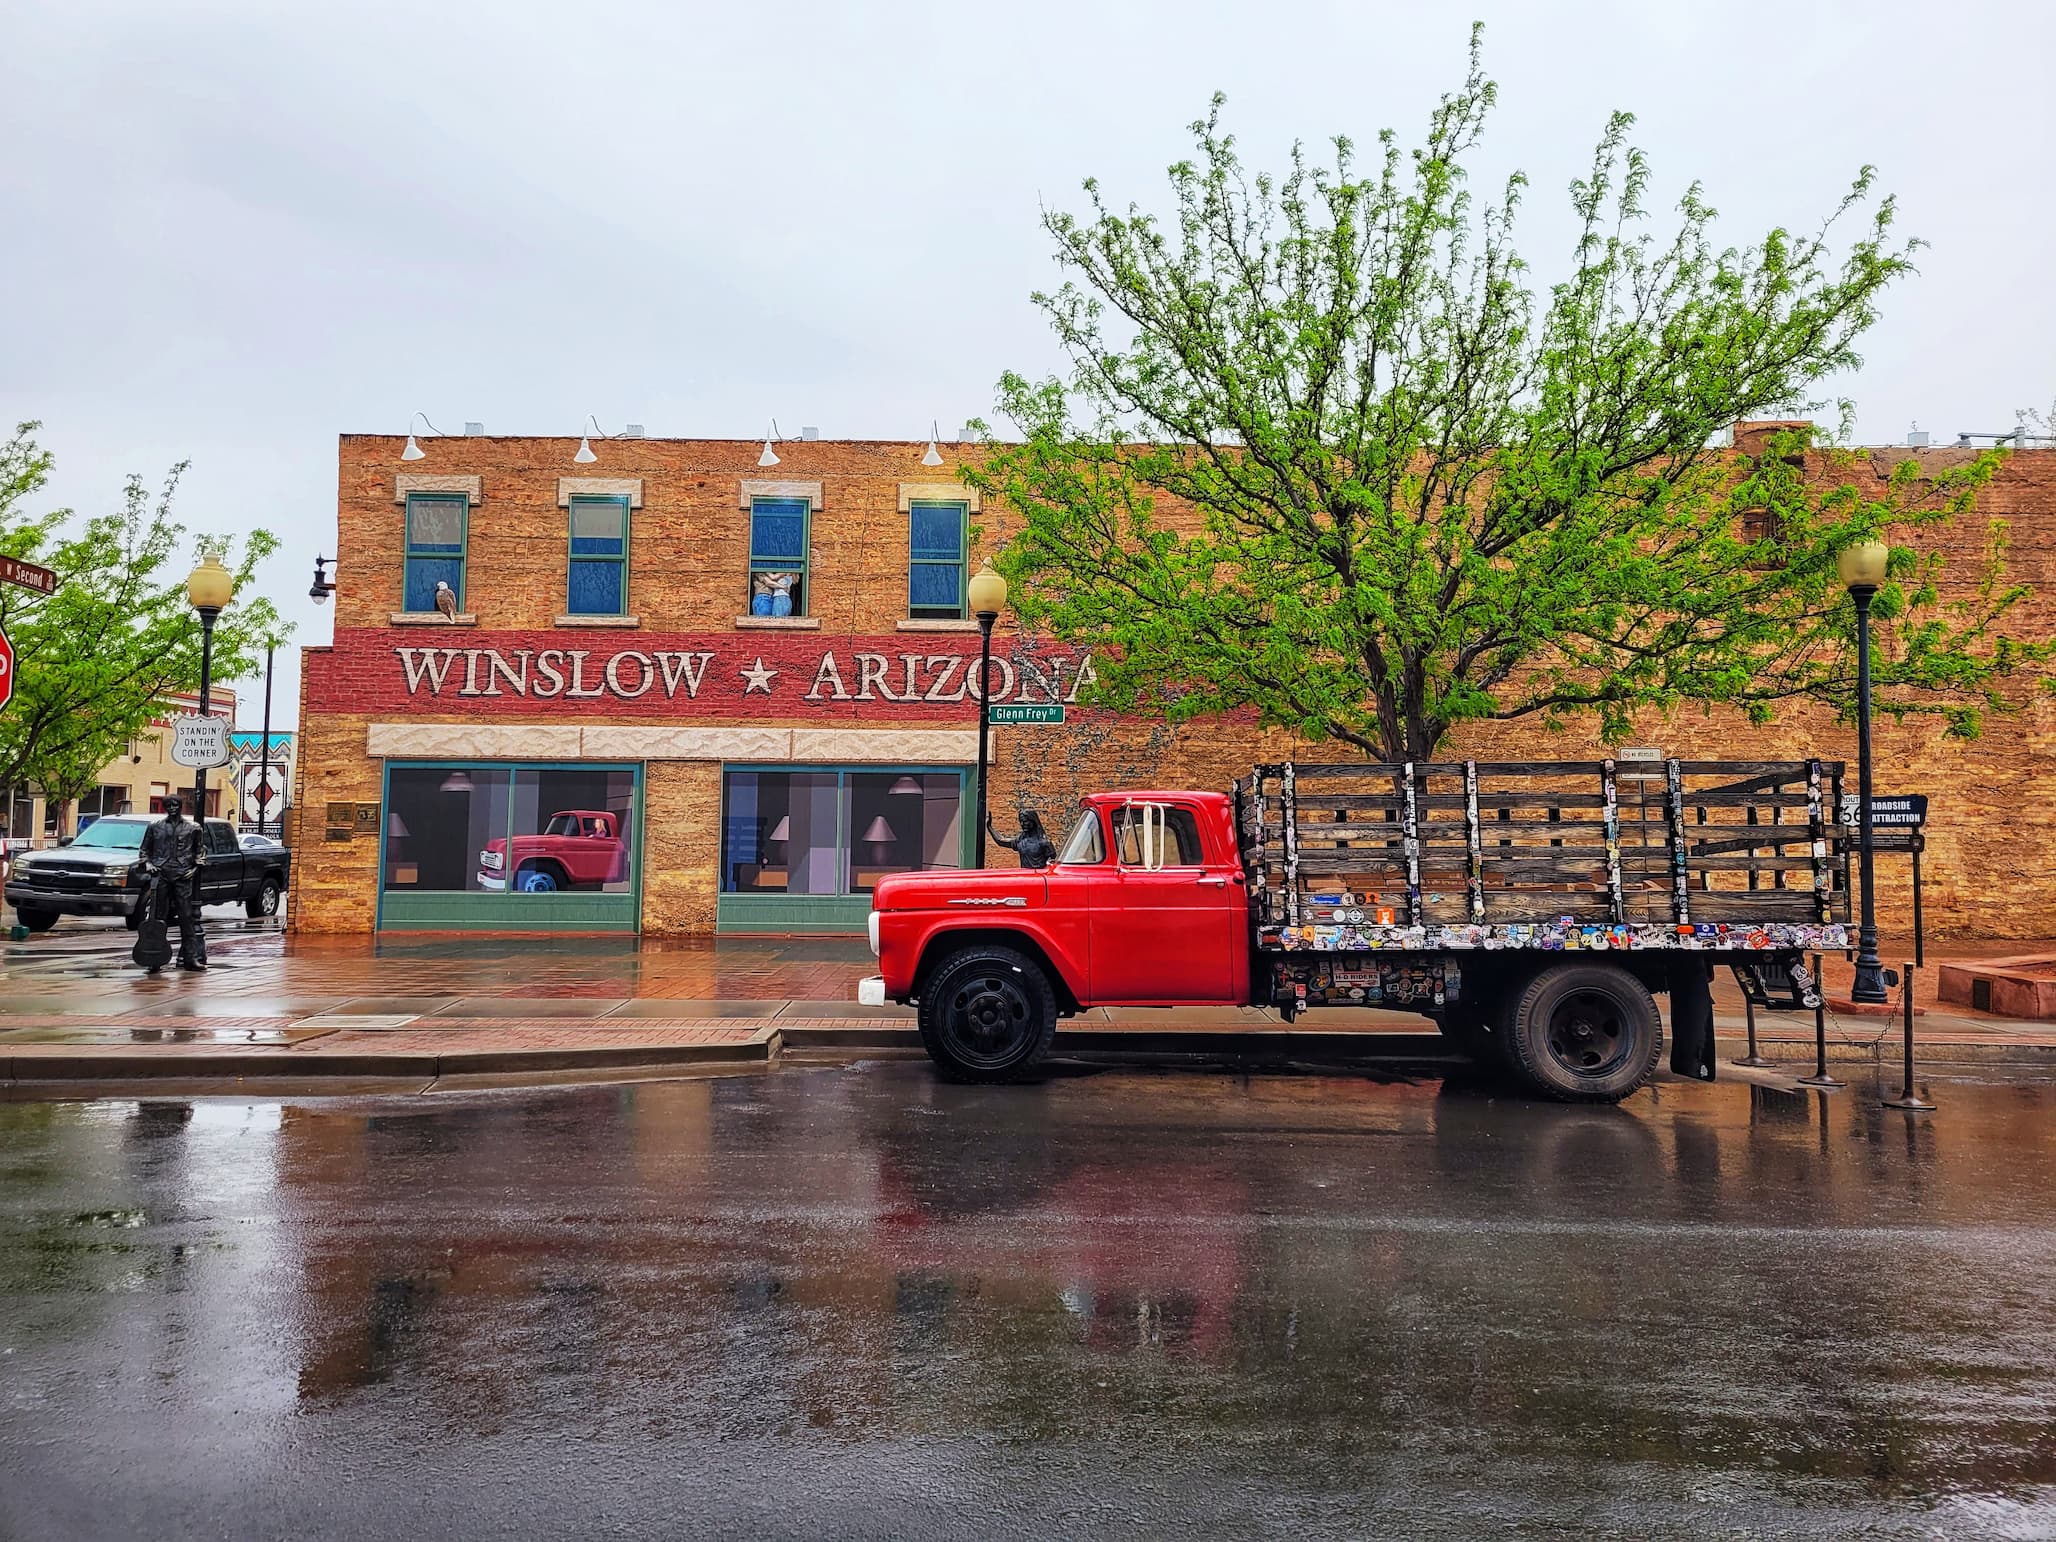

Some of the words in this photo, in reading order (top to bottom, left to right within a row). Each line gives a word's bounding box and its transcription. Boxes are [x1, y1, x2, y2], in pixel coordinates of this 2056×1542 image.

[6, 563, 12, 575] W
[15, 565, 43, 587] Second
[396, 648, 715, 698] WINSLOW
[996, 708, 1024, 719] Glenn
[1026, 708, 1047, 721] Frey
[180, 727, 221, 736] STANDIN'
[184, 738, 196, 747] ON
[199, 738, 216, 747] THE
[182, 749, 217, 758] CORNER
